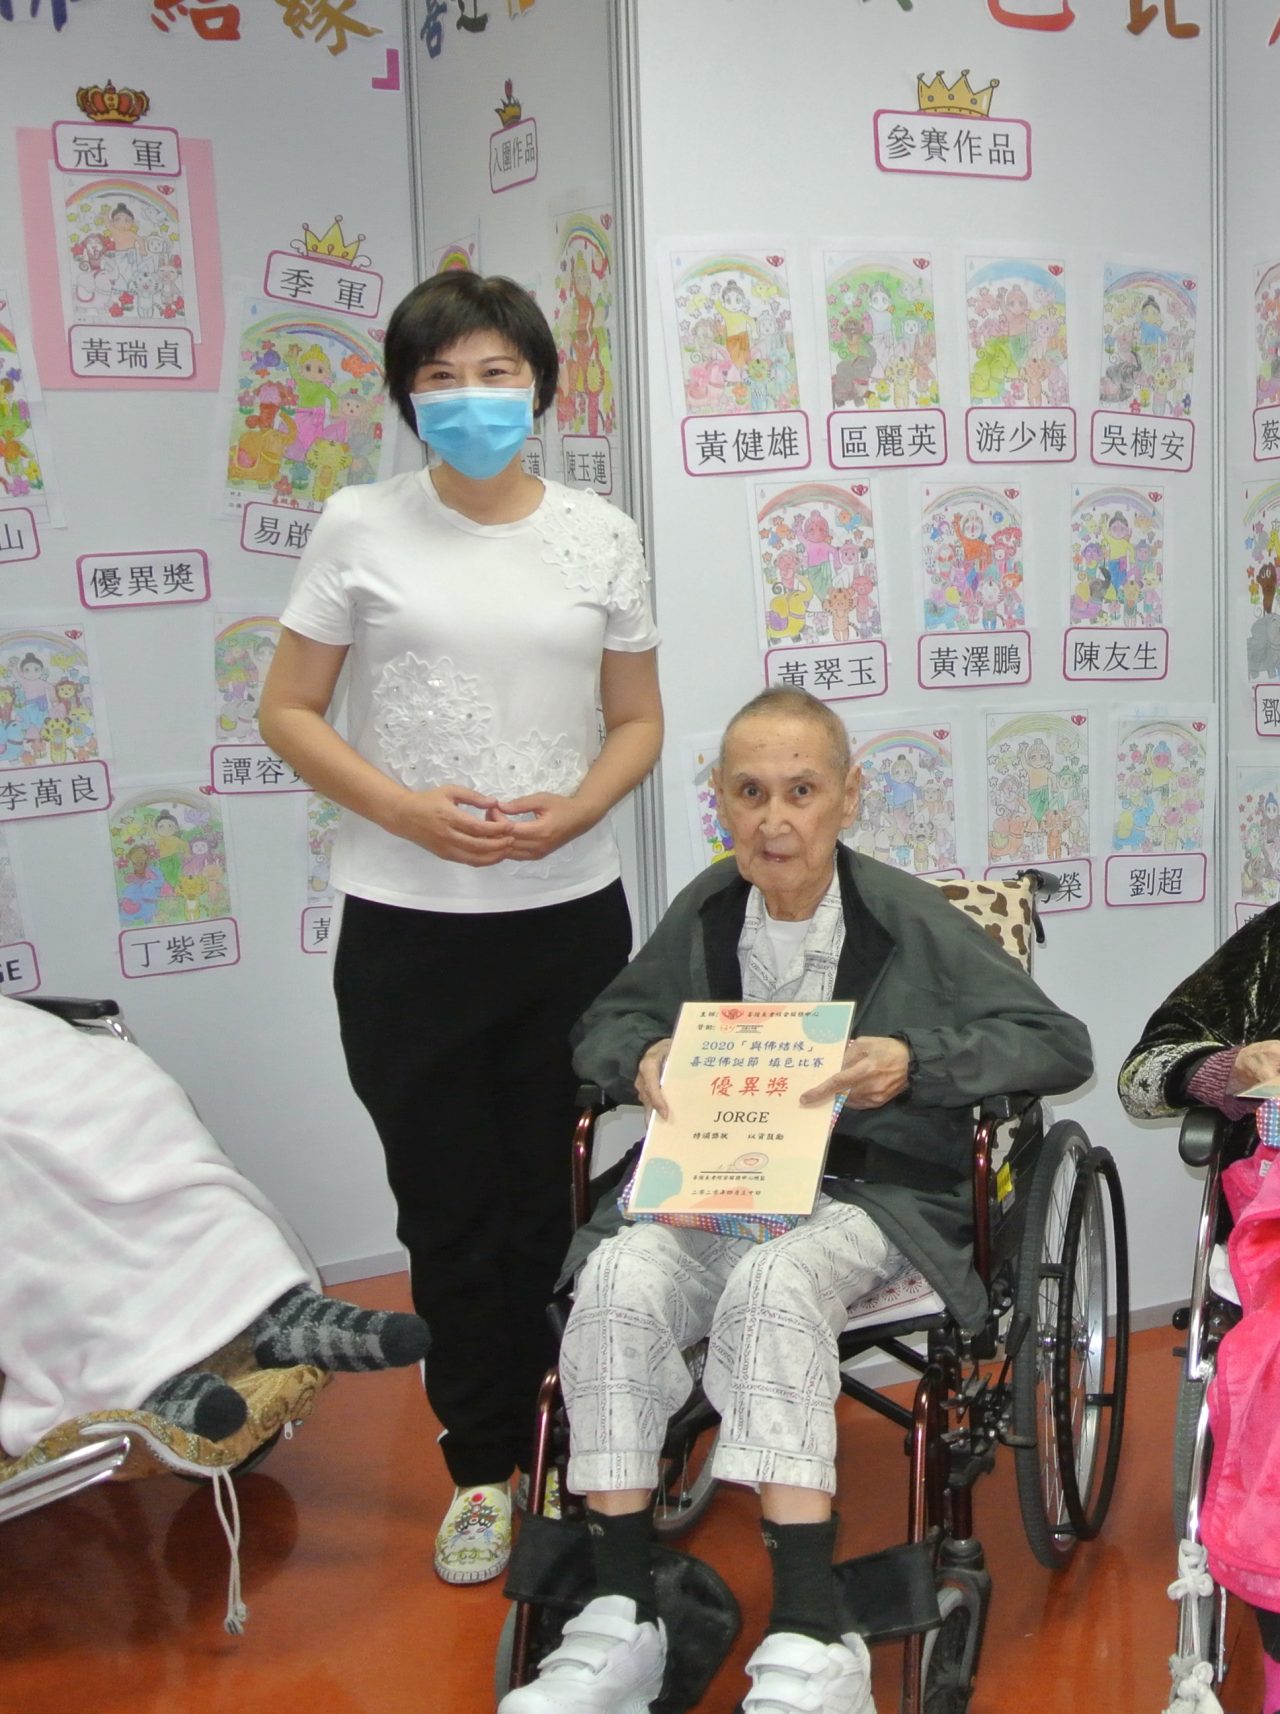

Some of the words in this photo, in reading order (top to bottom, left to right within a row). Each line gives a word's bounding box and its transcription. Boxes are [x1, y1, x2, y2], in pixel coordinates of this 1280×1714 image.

[73, 136, 165, 171] 冠軍
[885, 126, 1017, 167] 參賽作品
[279, 268, 366, 311] 季軍
[81, 337, 180, 372] 黃瑞貞
[695, 425, 800, 463] 黃健雄
[840, 422, 938, 459] 區麗英
[975, 419, 1068, 455] 游少梅
[1100, 422, 1186, 462] 吳樹安
[90, 563, 195, 599] 優異獎
[928, 642, 1023, 679] 黃澤鵬
[1072, 640, 1160, 673] 陳友生
[0, 774, 98, 811] 李萬良
[1129, 866, 1183, 897] 劉超
[131, 930, 228, 968] 丁紫雲
[713, 1111, 770, 1123] JORGE
